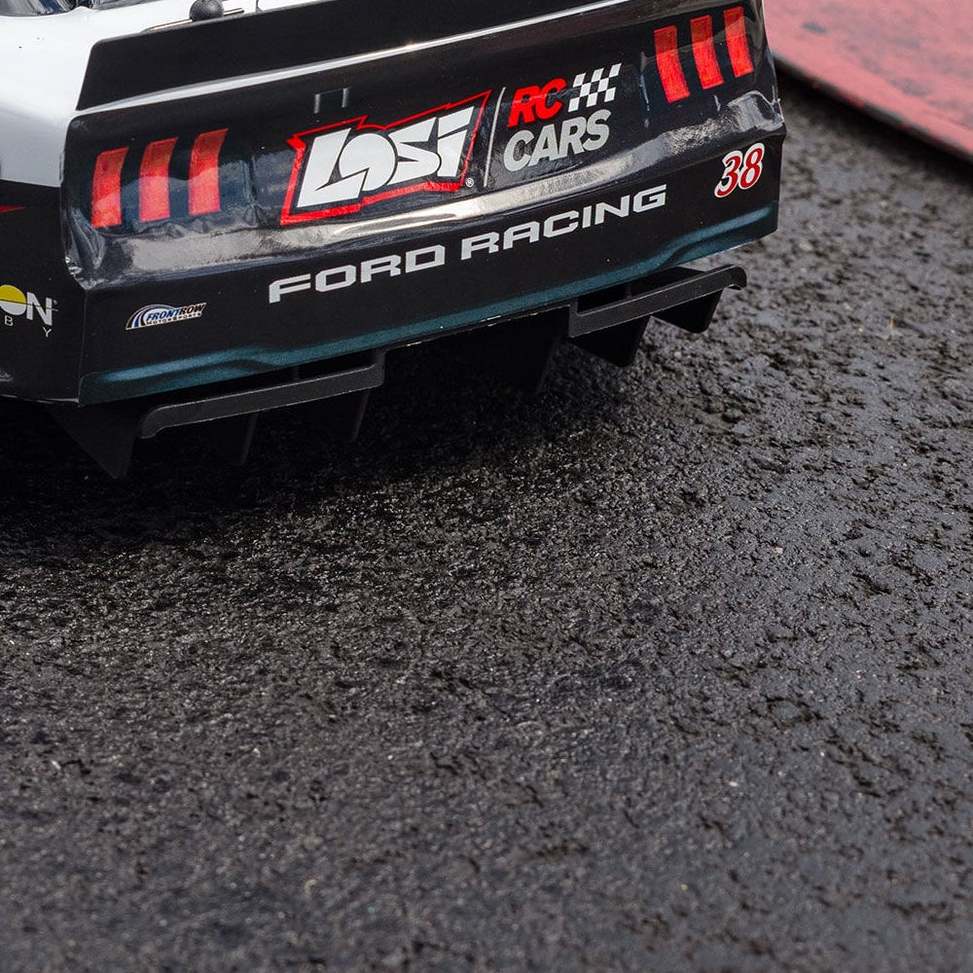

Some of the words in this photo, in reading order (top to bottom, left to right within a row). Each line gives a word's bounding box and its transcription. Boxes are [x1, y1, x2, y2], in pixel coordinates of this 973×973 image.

[508, 78, 568, 128] RC
[503, 108, 611, 173] CARS
[714, 142, 765, 198] 38
[268, 243, 446, 304] FORD
[460, 183, 668, 260] RACING
